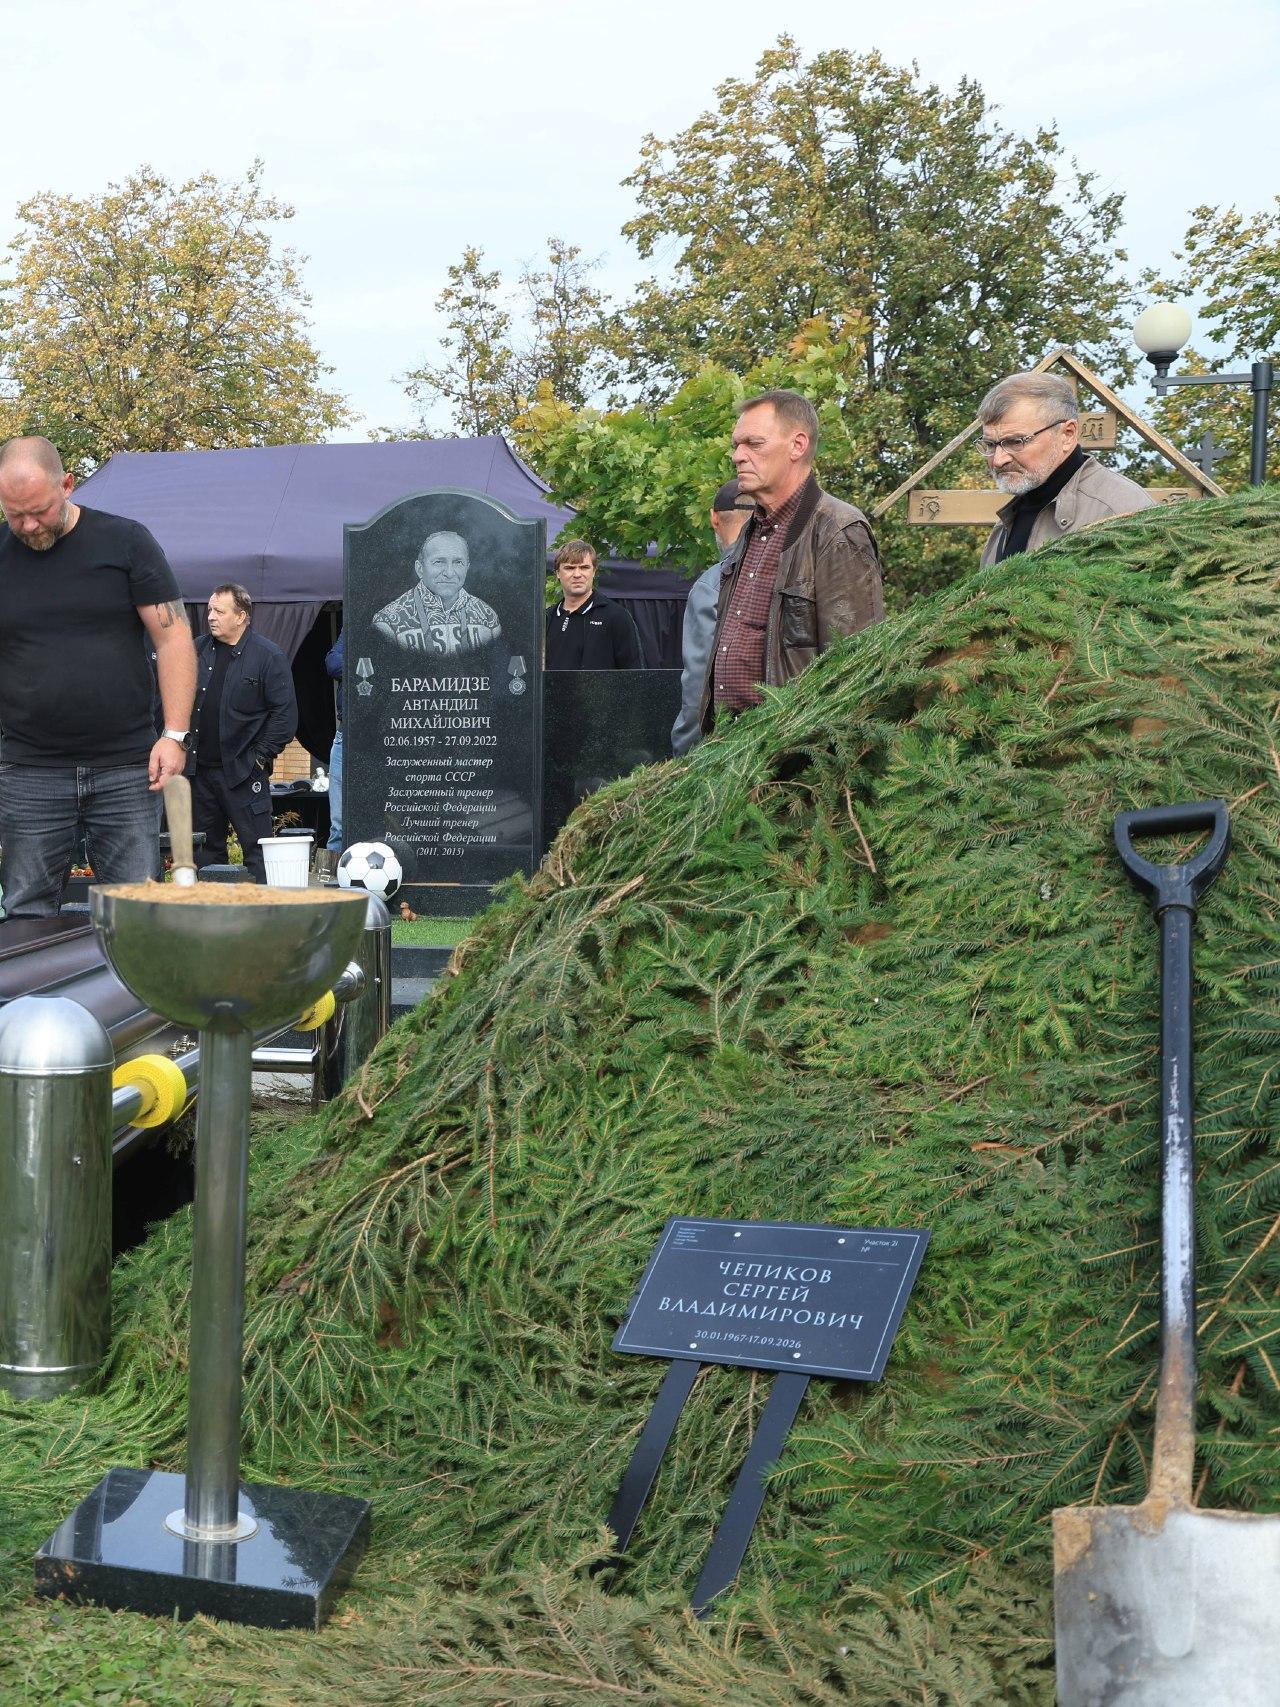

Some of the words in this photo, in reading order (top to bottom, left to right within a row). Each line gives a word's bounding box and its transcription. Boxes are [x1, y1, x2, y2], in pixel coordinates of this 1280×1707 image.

[390, 677, 491, 694] БАРАМИДЗЕ
[402, 698, 479, 712] АВТАНДИЛ
[390, 714, 491, 729] МИХАЙЛОВИЧ
[383, 736, 436, 747] 02.06.1957
[444, 735, 498, 746] 27.09.2022
[385, 756, 453, 768] Заслуженный
[454, 758, 494, 768] мастер
[405, 774, 442, 784] спорта
[444, 771, 476, 782] СССР
[387, 786, 455, 799] Заслуженный
[456, 788, 494, 799] тренер
[383, 801, 440, 812] Российской
[442, 802, 497, 814] Федерации
[401, 816, 441, 829] Лучший
[442, 820, 479, 829] тренер
[384, 832, 440, 842] Российской
[442, 832, 497, 844] Федерации
[719, 1261, 832, 1284] ЧЕПИКОВ
[723, 1282, 810, 1303] СЕРГЕЙ
[658, 1296, 865, 1330] ВЛАДИМИРОВИЧ
